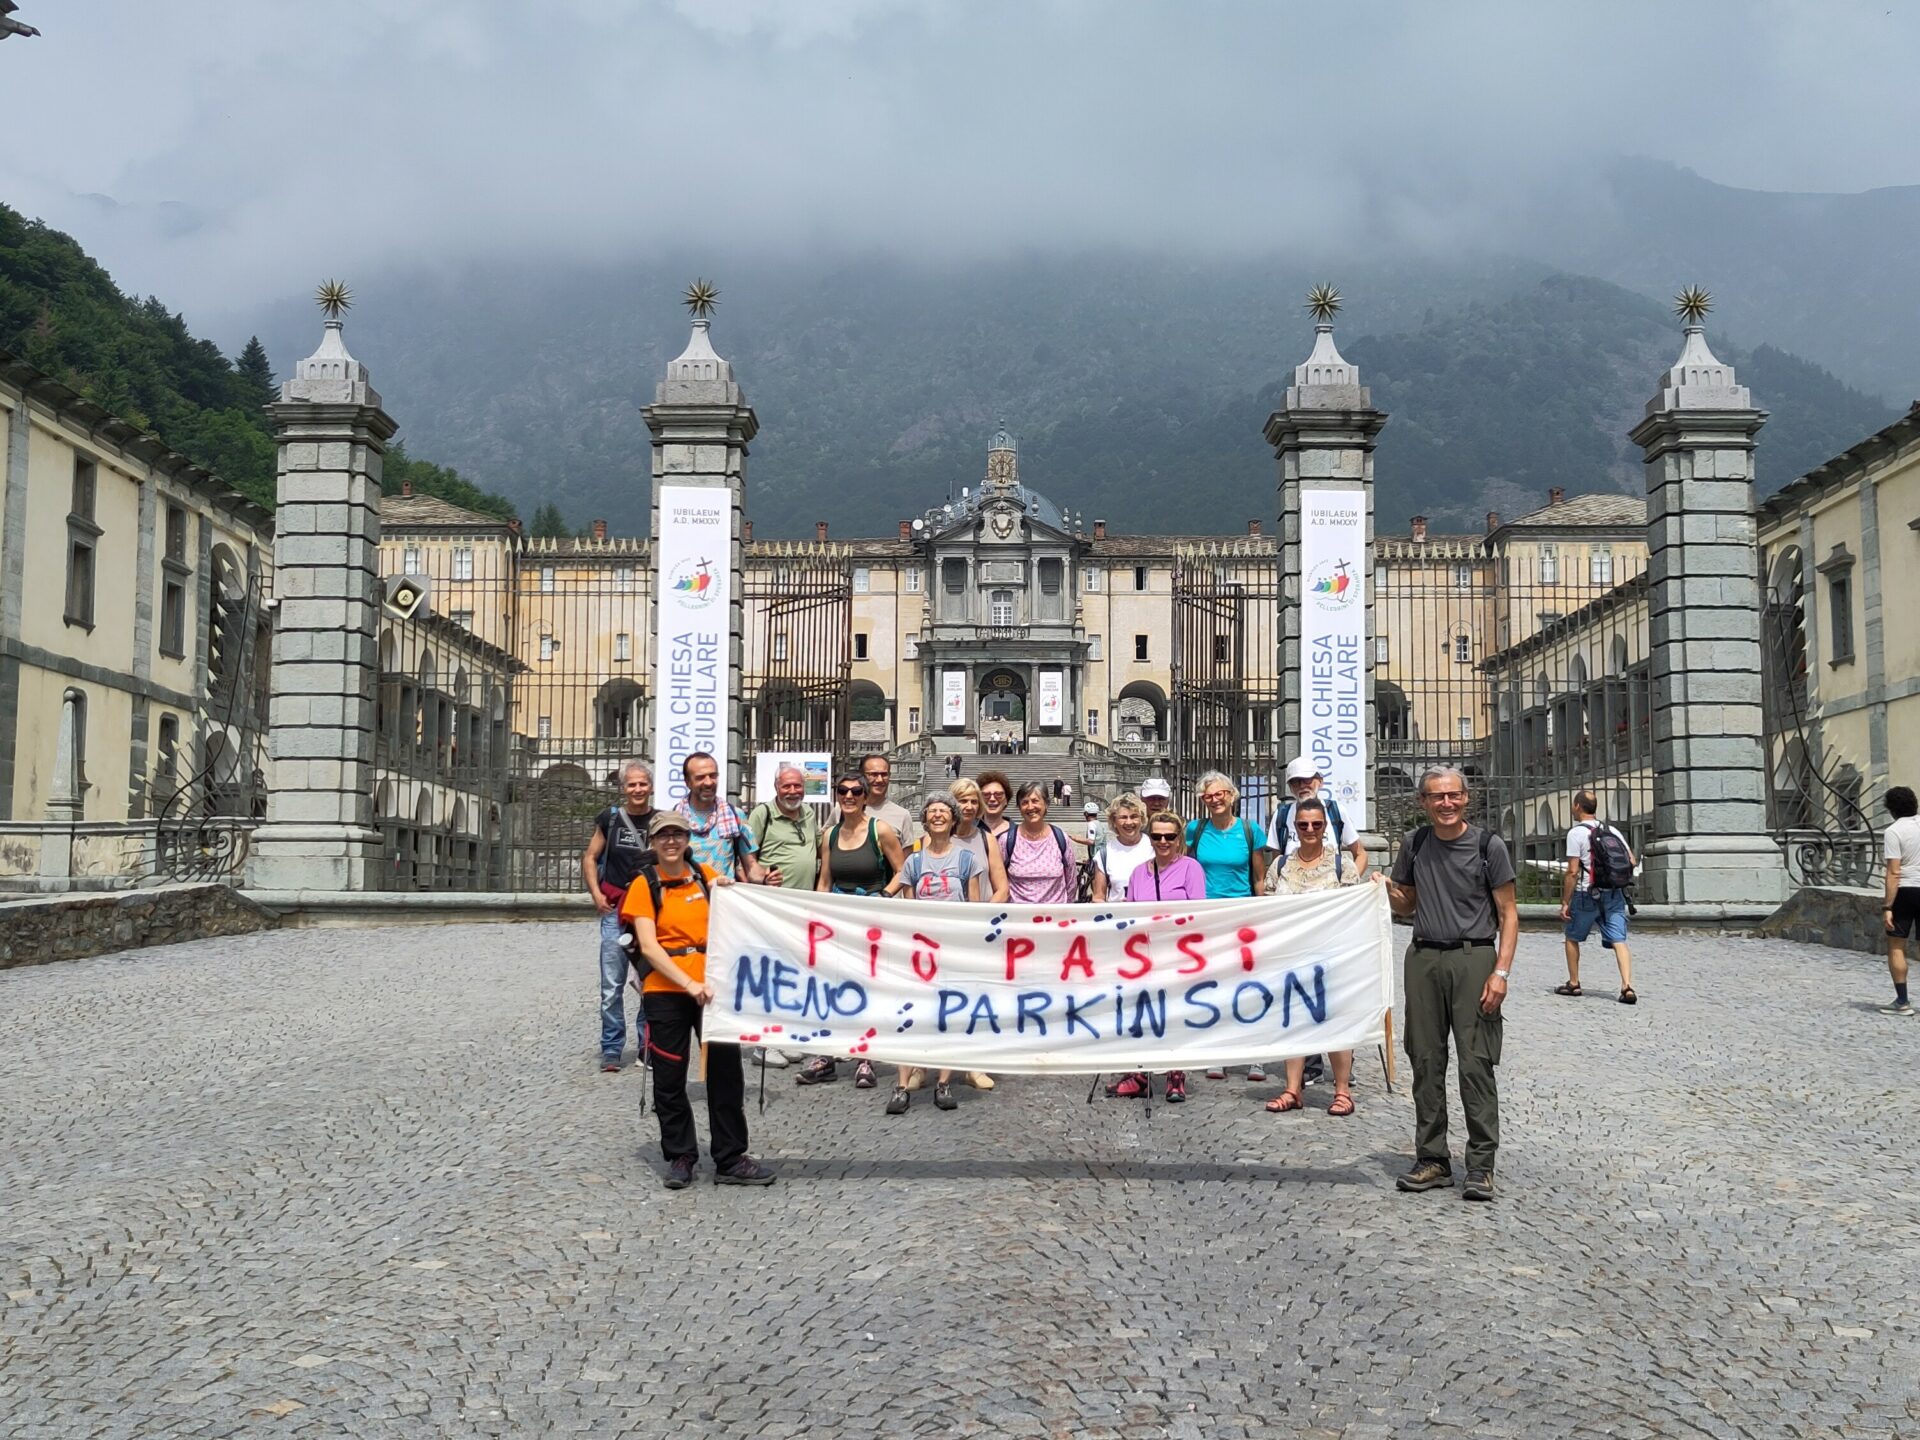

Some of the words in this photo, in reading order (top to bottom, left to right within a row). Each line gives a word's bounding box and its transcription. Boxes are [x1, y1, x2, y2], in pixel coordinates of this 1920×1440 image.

[673, 508, 720, 516] IUBILAEUM
[670, 632, 693, 715] CHIESA
[694, 632, 718, 754] GIUBILARE
[1312, 634, 1333, 717] CHIESA
[1337, 634, 1358, 757] GIUBILARE
[734, 955, 868, 1020] MENO
